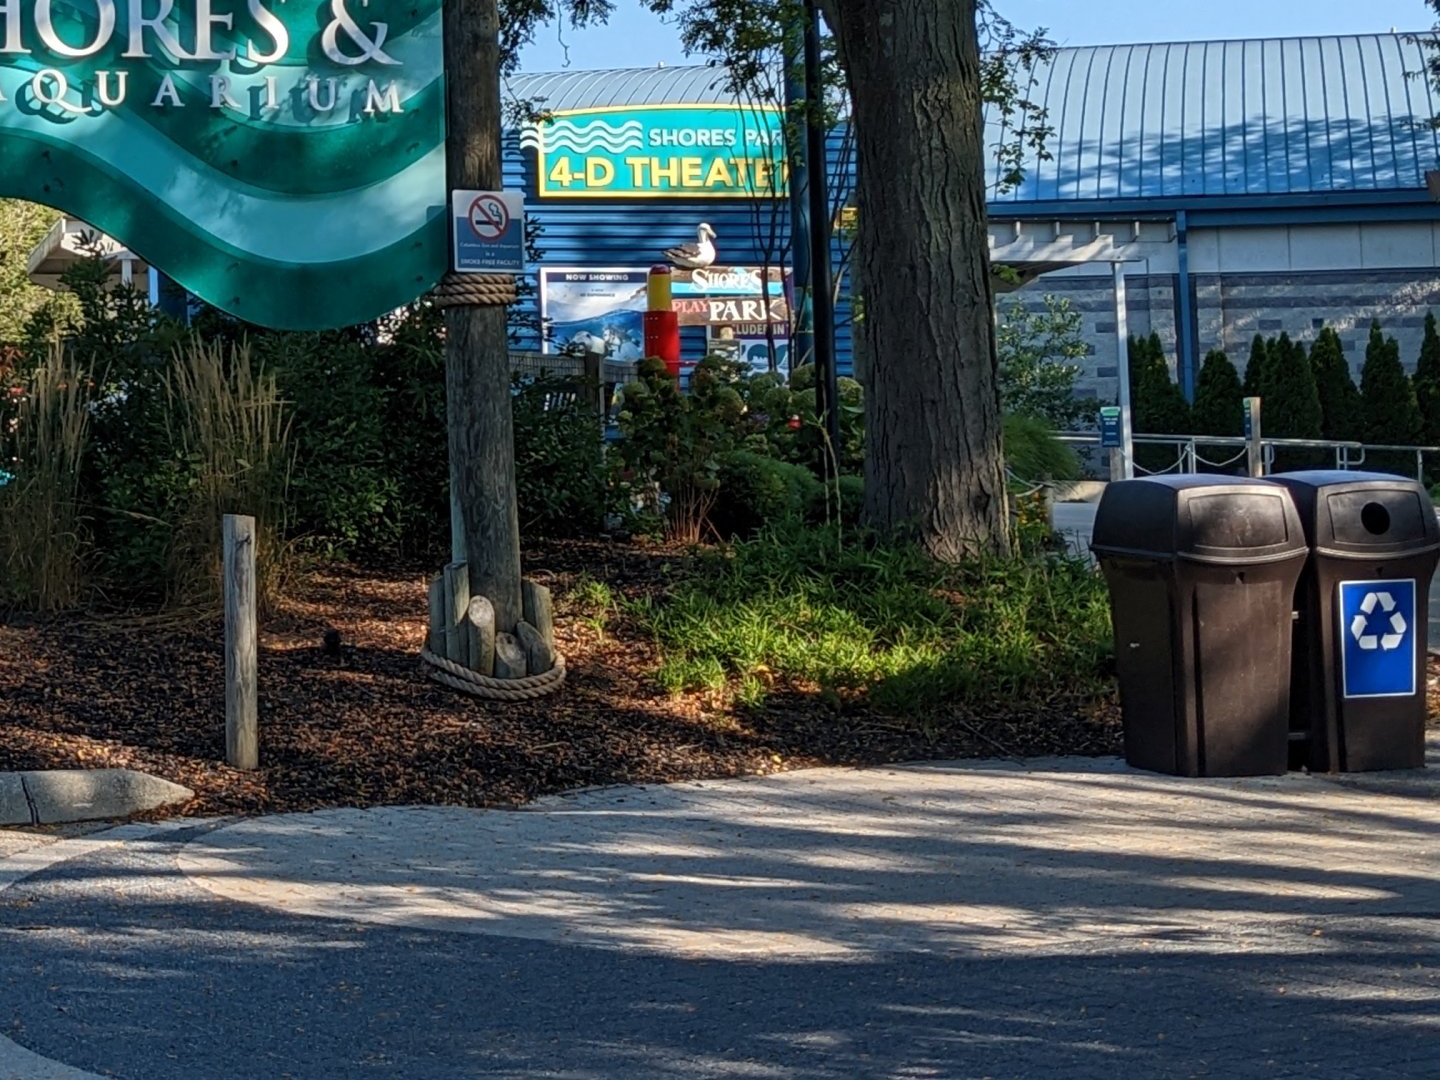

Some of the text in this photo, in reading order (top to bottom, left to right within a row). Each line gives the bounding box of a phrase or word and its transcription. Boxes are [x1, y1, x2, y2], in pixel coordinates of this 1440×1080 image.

[649, 128, 784, 148] SHORES PAR
[549, 157, 791, 188] 4-D THEATE
[691, 268, 763, 292] SHORES
[671, 299, 782, 321] PLAY PARK
